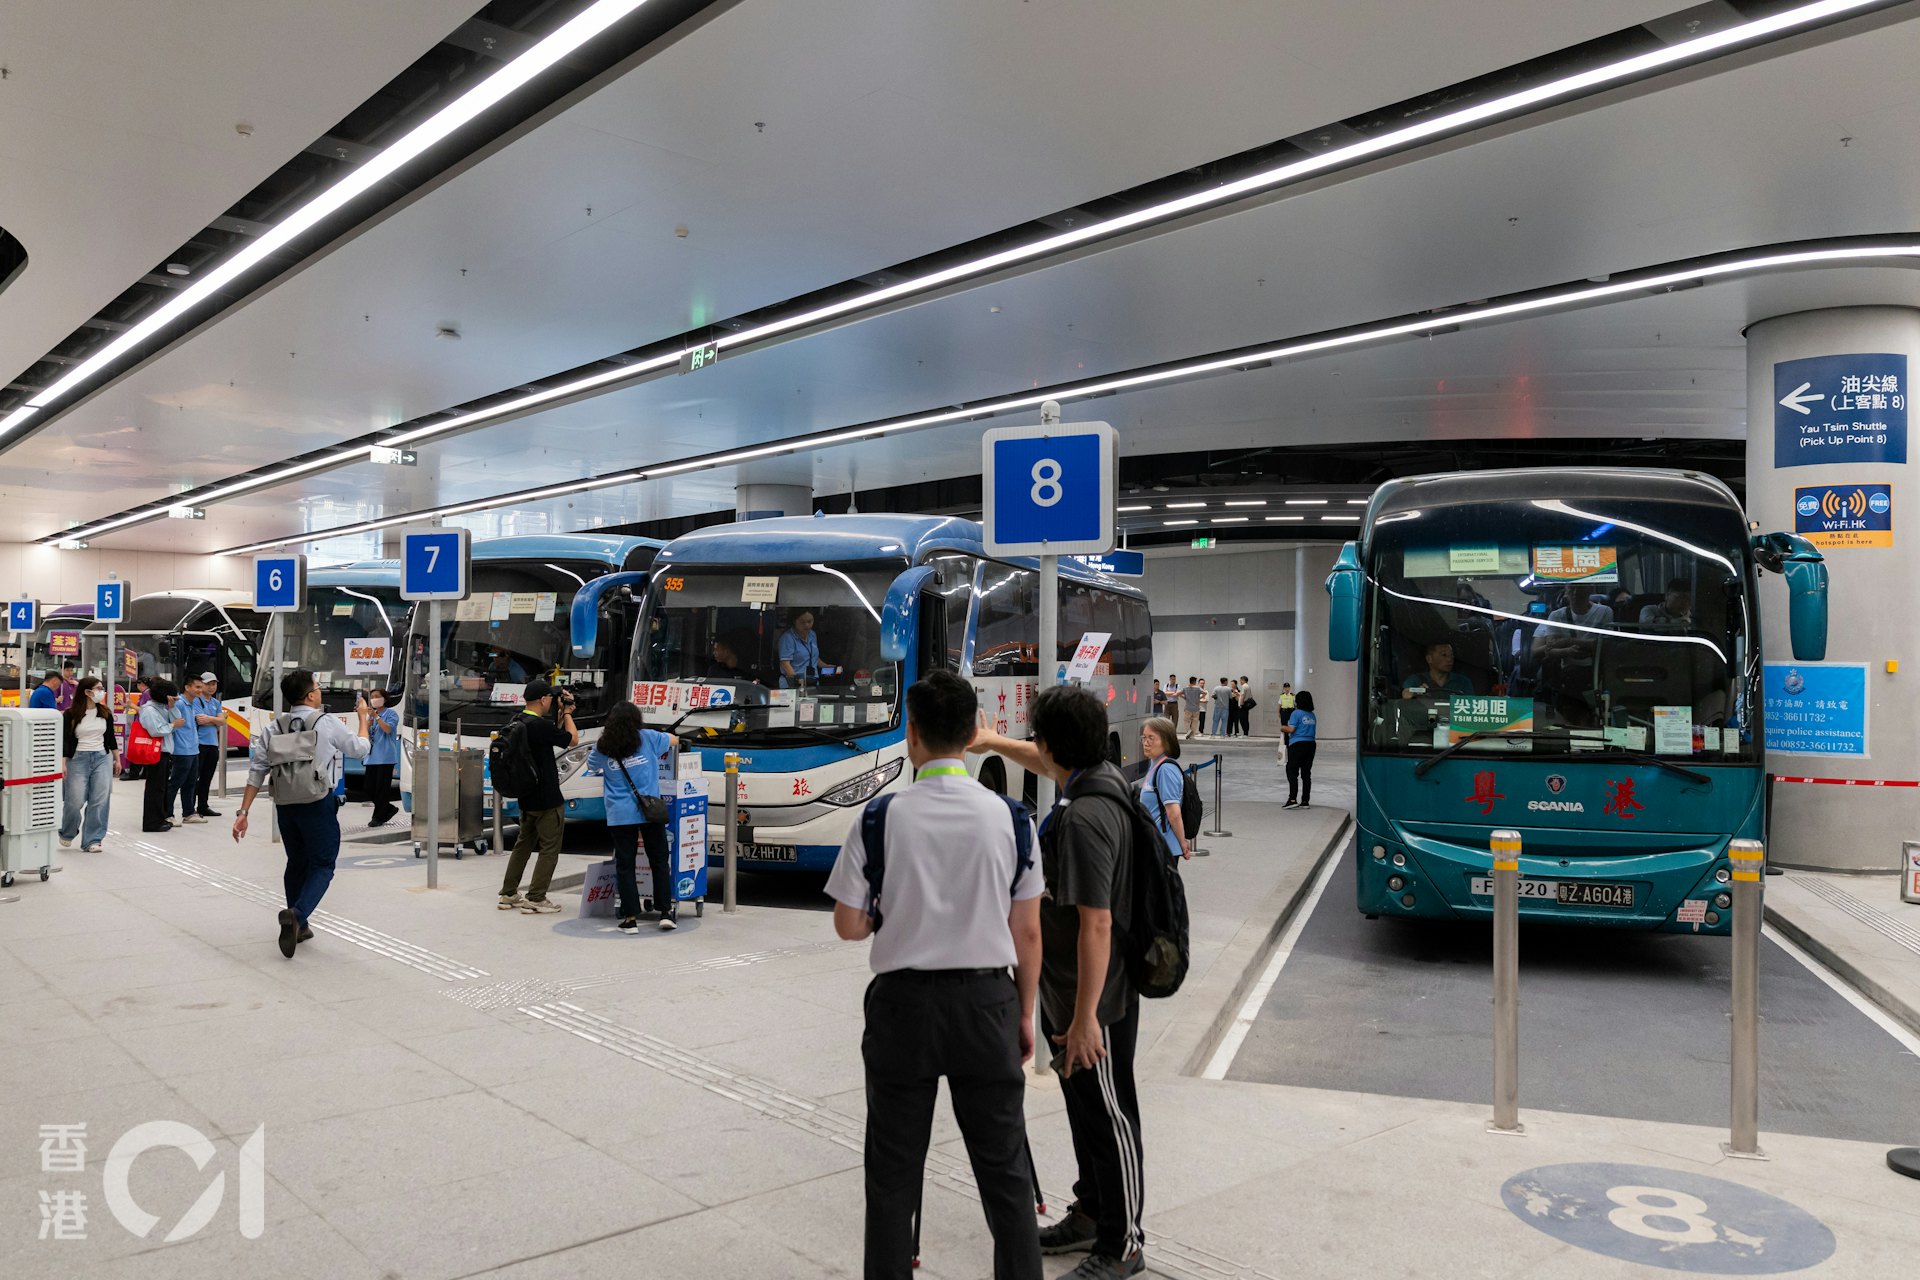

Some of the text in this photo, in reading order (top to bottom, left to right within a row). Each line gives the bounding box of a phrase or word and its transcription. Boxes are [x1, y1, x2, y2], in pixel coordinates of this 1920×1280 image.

[1841, 375, 1898, 393] 油尖線
[1831, 395, 1905, 411] (上客點 8)
[1800, 422, 1887, 434] Yau Tsim Shuttle
[1800, 433, 1887, 447] (Pick Up Point 8)
[1031, 458, 1063, 507] 8
[1798, 500, 1819, 511] 免費
[1870, 499, 1888, 507] FREE
[1822, 519, 1866, 529] Wi-Fi.HK
[424, 546, 440, 573] 7
[269, 568, 282, 591] 6
[664, 577, 684, 591] 355
[104, 591, 113, 607] 5
[17, 607, 26, 620] 4
[53, 635, 77, 647] 荃灣
[350, 647, 385, 659] 旺角線
[634, 683, 668, 705] 灣仔
[1453, 699, 1507, 715] 尖沙咀
[1764, 699, 1848, 710] 警方協助，請致電
[997, 720, 1007, 735] CTS
[1764, 727, 1864, 739] equire police assistance,
[1766, 739, 1857, 752] dial 00852-36611732.
[792, 778, 812, 796] 旅
[1603, 777, 1645, 818] 港
[1527, 801, 1584, 812] SCANIA
[1606, 1185, 1718, 1243] 8
